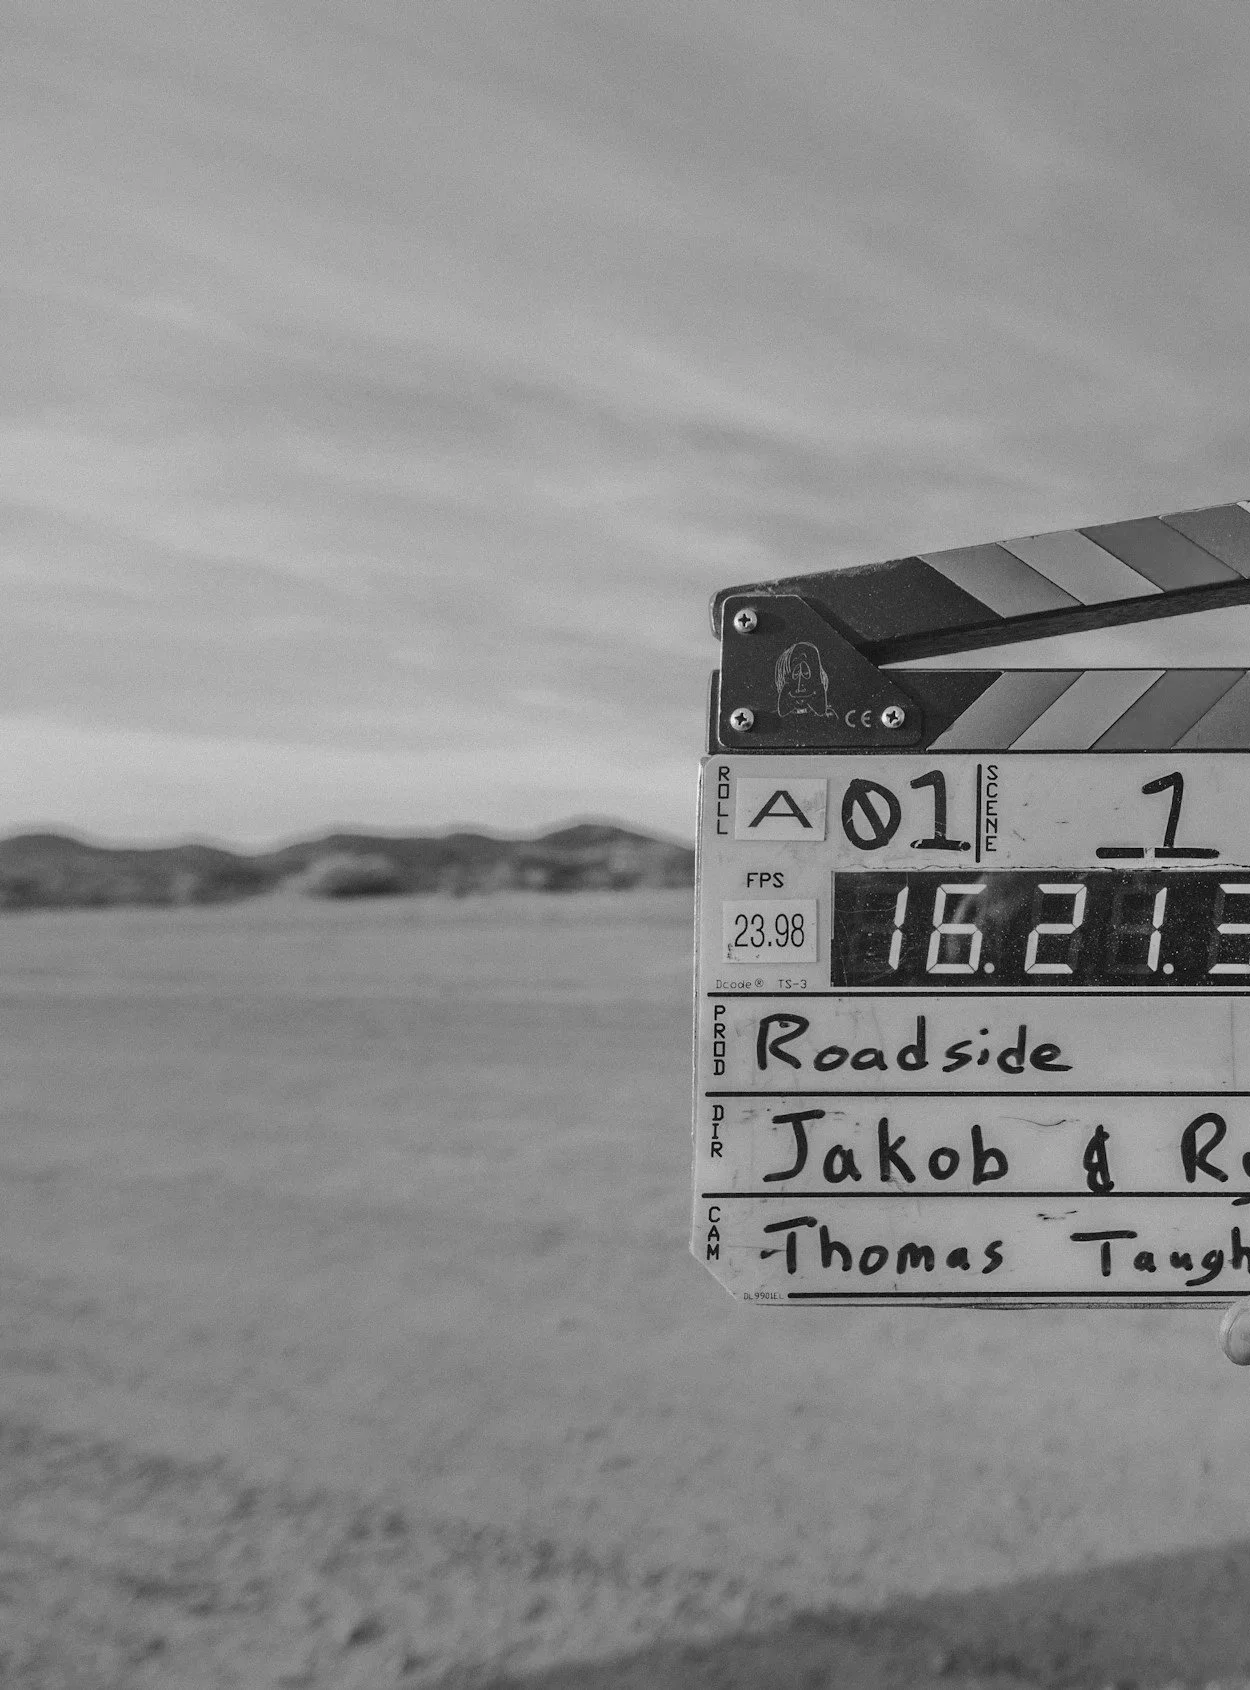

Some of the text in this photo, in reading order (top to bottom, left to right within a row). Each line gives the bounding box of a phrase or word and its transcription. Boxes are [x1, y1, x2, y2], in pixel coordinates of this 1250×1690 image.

[844, 709, 873, 729] CE
[716, 765, 730, 835] ROLL
[748, 790, 813, 829] A
[841, 769, 972, 852] 01
[985, 764, 999, 853] SCENE
[746, 872, 784, 889] FPS
[733, 913, 805, 948] 23.98
[778, 979, 808, 990] TS-3
[713, 1004, 726, 1076] PROD
[756, 1013, 1074, 1073] Roadside
[710, 1104, 725, 1158] DIR
[762, 1108, 1009, 1185] Jakob
[706, 1205, 721, 1261] CAM
[760, 1216, 1004, 1275] Thomas
